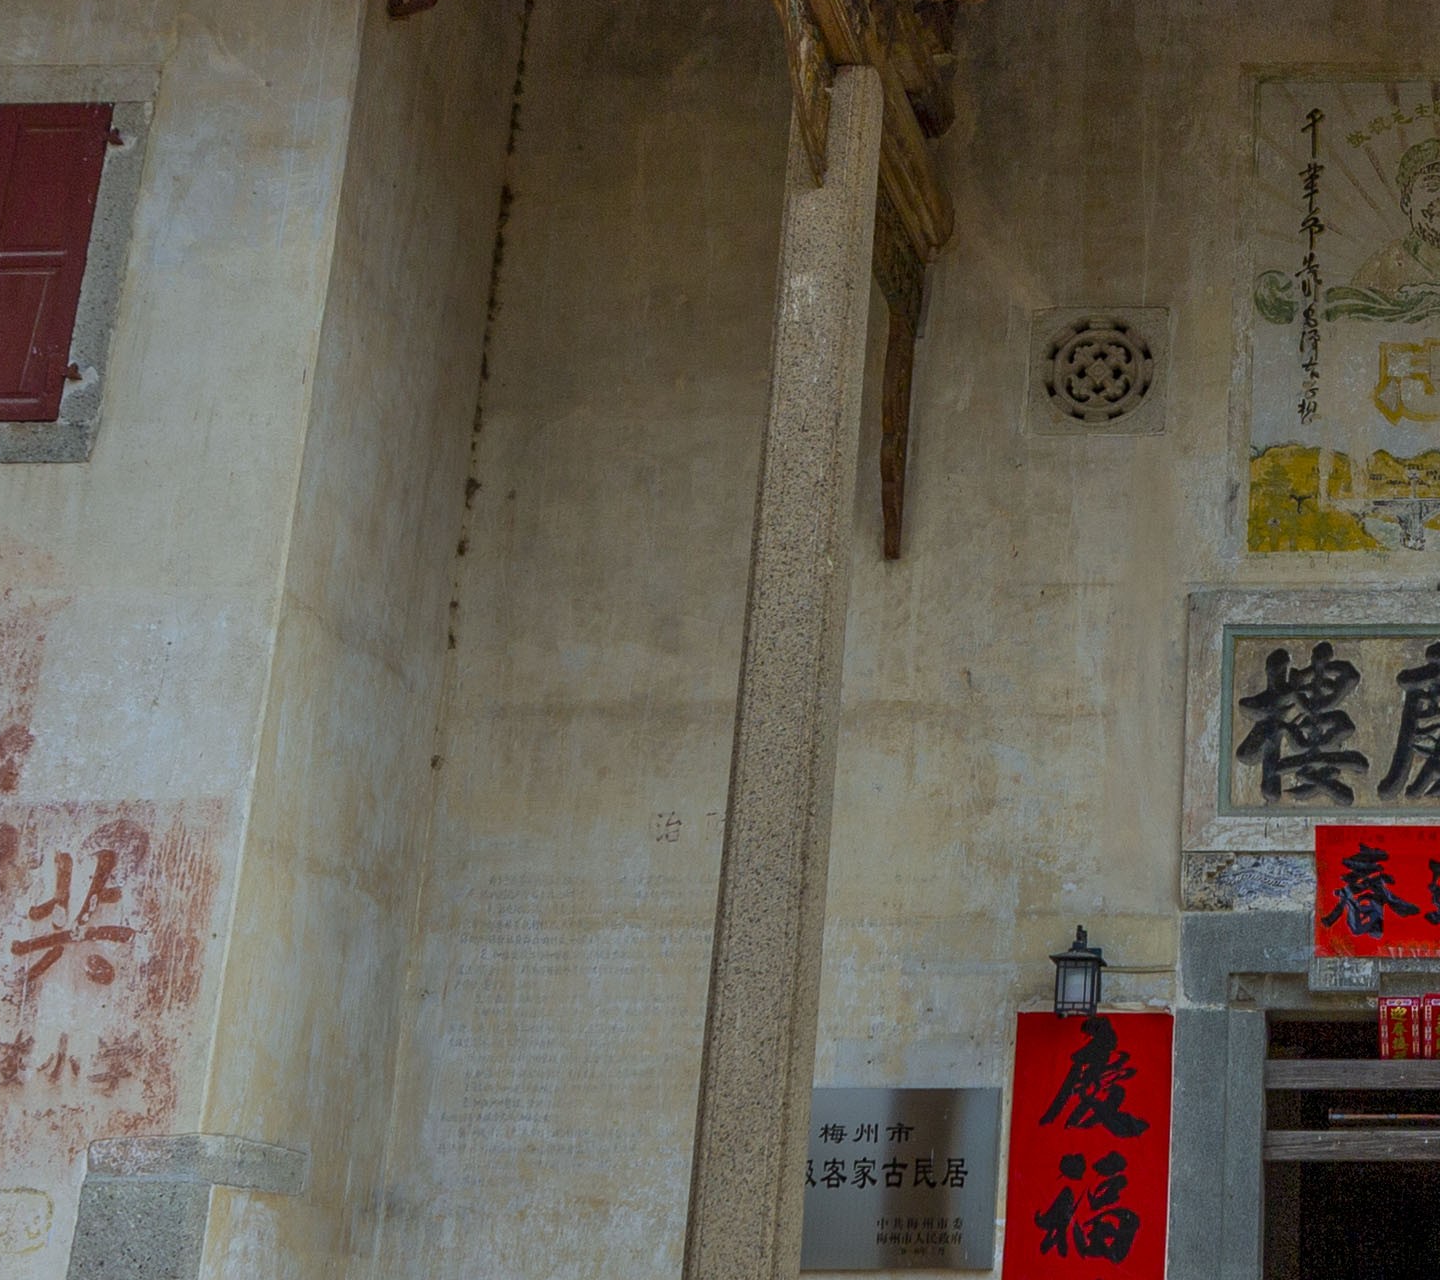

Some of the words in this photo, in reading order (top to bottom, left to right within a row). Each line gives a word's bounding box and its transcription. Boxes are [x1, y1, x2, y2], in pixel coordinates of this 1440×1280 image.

[819, 1122, 915, 1144] 梅州市
[876, 1231, 963, 1246] 梅州市人民政府
